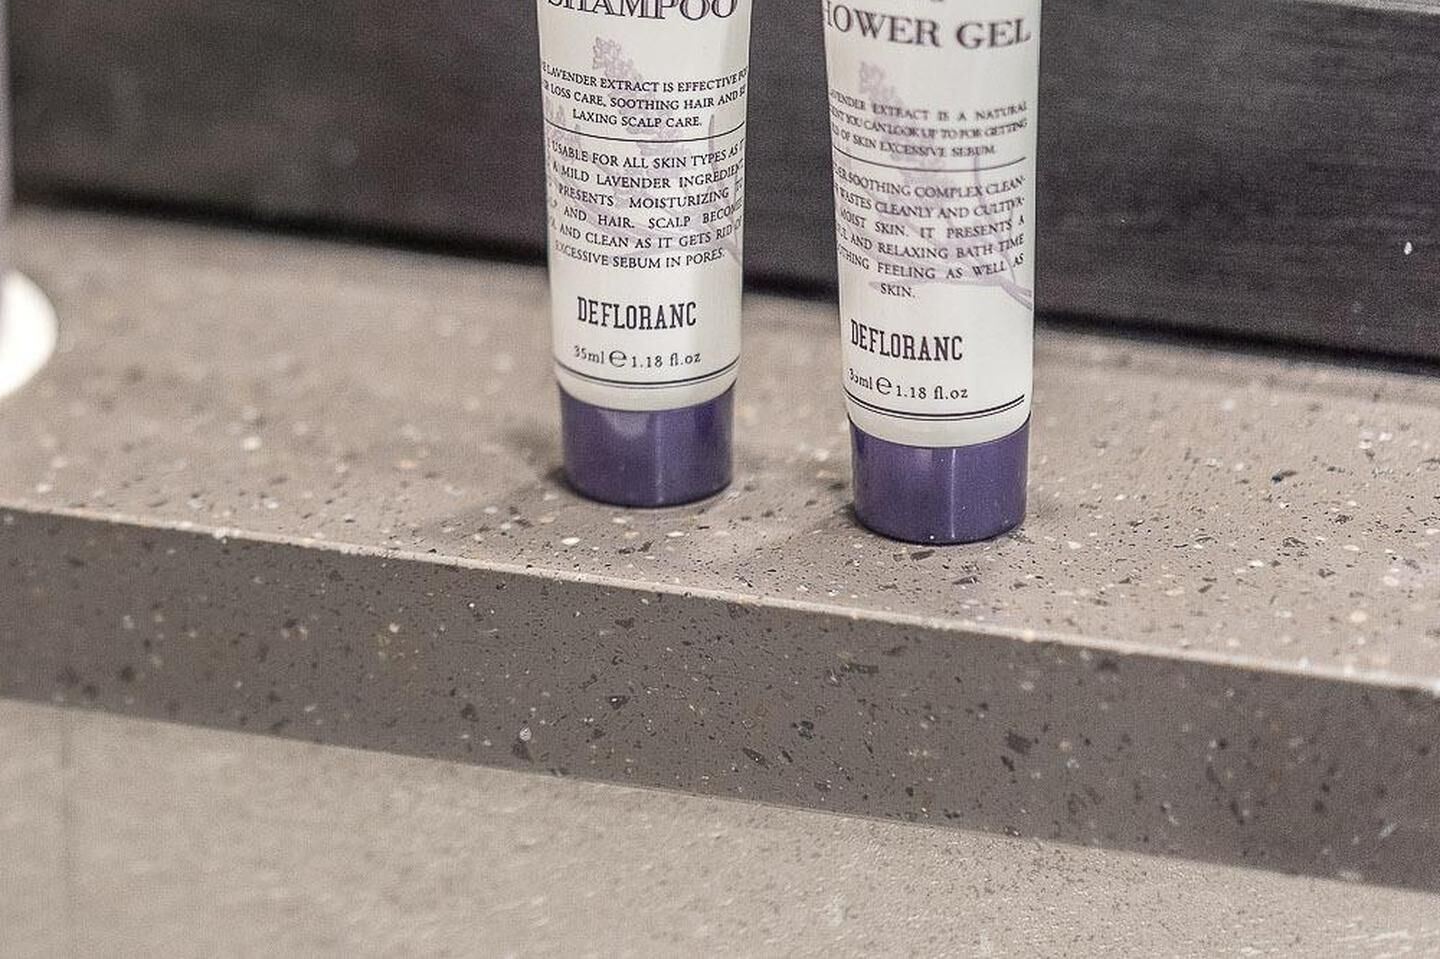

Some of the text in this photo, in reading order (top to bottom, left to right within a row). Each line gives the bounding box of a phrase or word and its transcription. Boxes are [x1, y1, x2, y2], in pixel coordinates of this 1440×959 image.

[956, 19, 1031, 49] GEL
[547, 65, 597, 86] LAVENDER
[600, 78, 658, 92] EXTRACT
[663, 82, 673, 93] IS
[678, 73, 738, 92] EFFECTIVE
[550, 85, 571, 99] LOSS
[610, 98, 679, 110] SOOTHING
[684, 97, 714, 109] HAIR
[718, 92, 738, 105] AND
[573, 109, 702, 128] LAXING SCALP CARE.
[871, 103, 929, 120] EXTRACT
[958, 111, 967, 121] A
[976, 101, 1027, 119] NATURAL
[864, 121, 886, 133] CAN
[941, 129, 958, 139] TO
[985, 120, 1027, 136] GETTING
[552, 141, 588, 162] USABLE
[592, 153, 619, 167] FOR
[623, 158, 648, 168] ALL
[653, 157, 686, 169] SKIN
[691, 150, 726, 167] TYPES
[728, 144, 738, 158] AS
[853, 134, 877, 148] SKIN
[880, 142, 945, 157] EXCESSIVE
[561, 166, 590, 182] MILD
[597, 174, 670, 188] LAVENDER
[848, 173, 910, 196] SOOTHING
[914, 186, 983, 198] COMPLEX
[559, 183, 729, 208] PRESENTS MOISTURIZING
[564, 207, 587, 221] AND
[598, 215, 635, 228] HAIR.
[648, 216, 691, 229] SCALP
[875, 200, 934, 218] CLEANLY
[938, 206, 969, 219] AND
[560, 224, 581, 239] AND
[585, 232, 628, 248] CLEAN
[635, 239, 651, 248] AS
[658, 237, 672, 248] IT
[679, 232, 711, 247] GETS
[716, 224, 732, 239] RID
[875, 221, 909, 237] SKIN.
[920, 227, 935, 238] IT
[947, 219, 1012, 239] PRESENTS
[613, 256, 660, 269] SEBUM
[666, 257, 681, 267] IN
[686, 247, 725, 266] PORES.
[851, 234, 1024, 259] AND RELAXING BATH TIME
[878, 262, 935, 279] FEELING
[946, 269, 962, 279] AS
[972, 261, 1007, 276] WELL
[1013, 254, 1024, 267] AS
[880, 283, 915, 298] SKIN.
[577, 296, 697, 330] DEFLORANC
[851, 319, 962, 361] DEFLORANC
[632, 356, 662, 368] 1.18
[896, 385, 926, 399] 1.18
